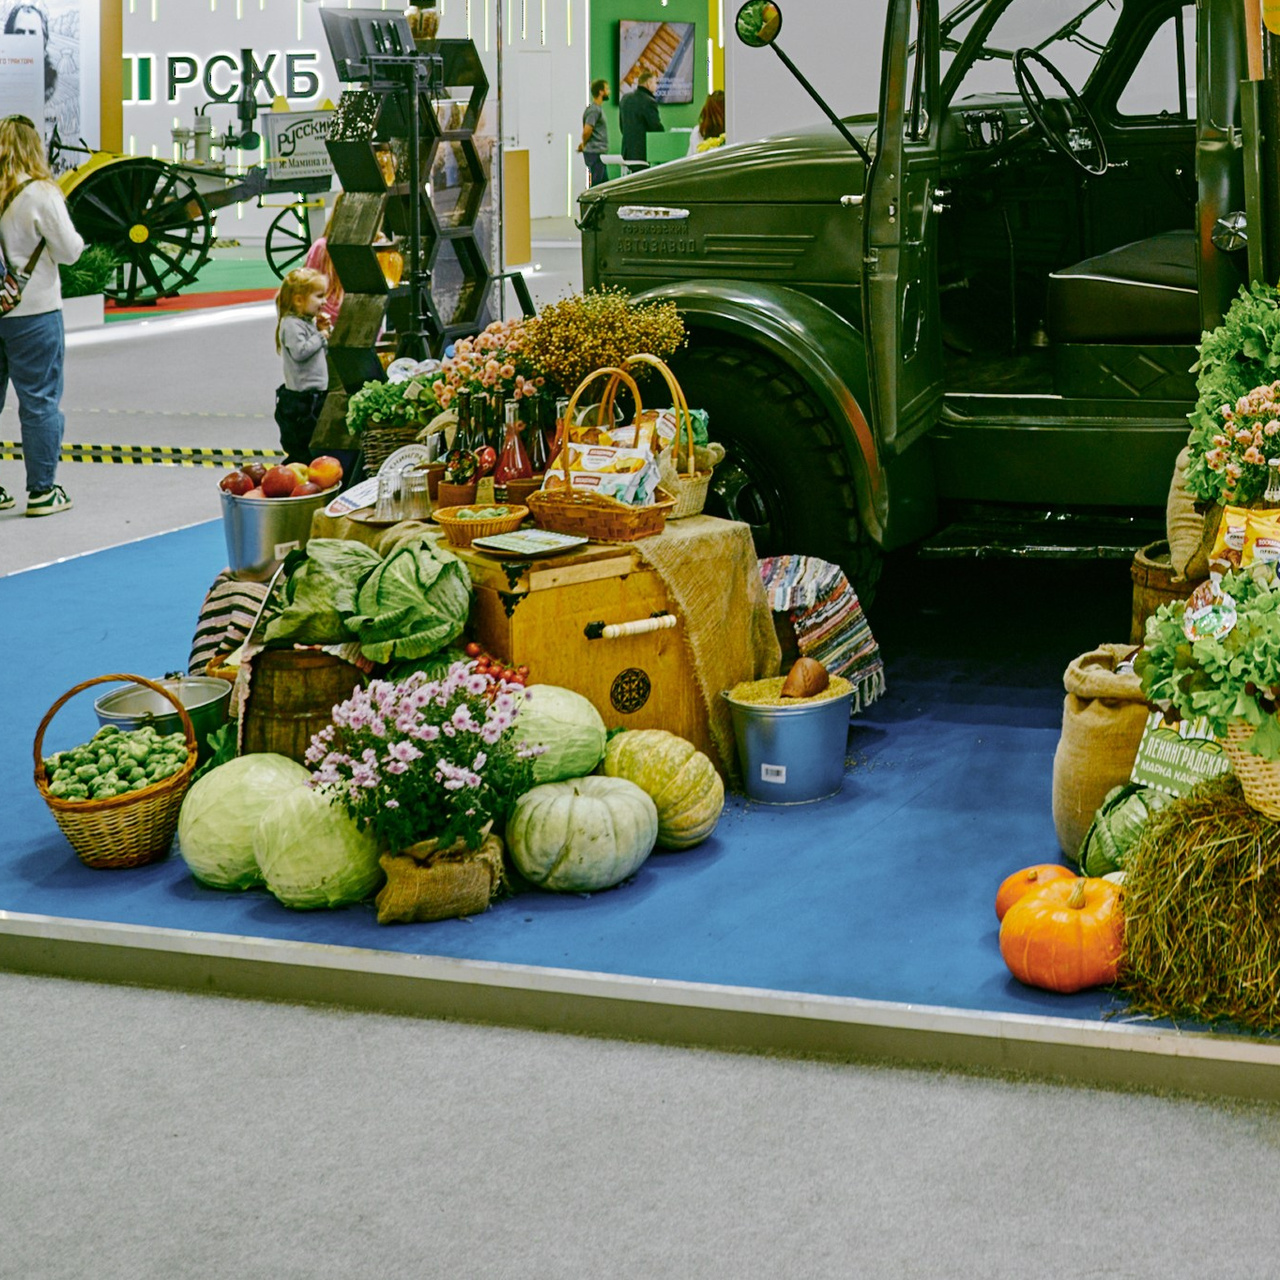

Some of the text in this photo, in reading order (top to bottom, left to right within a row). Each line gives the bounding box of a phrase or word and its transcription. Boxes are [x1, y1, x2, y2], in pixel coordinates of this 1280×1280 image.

[167, 53, 320, 102] РСХБ
[616, 237, 697, 254] АВТОЗАВОД
[1140, 760, 1172, 778] МАРКА
[1144, 736, 1230, 777] ЛЕНИНГРАДСКАЯ
